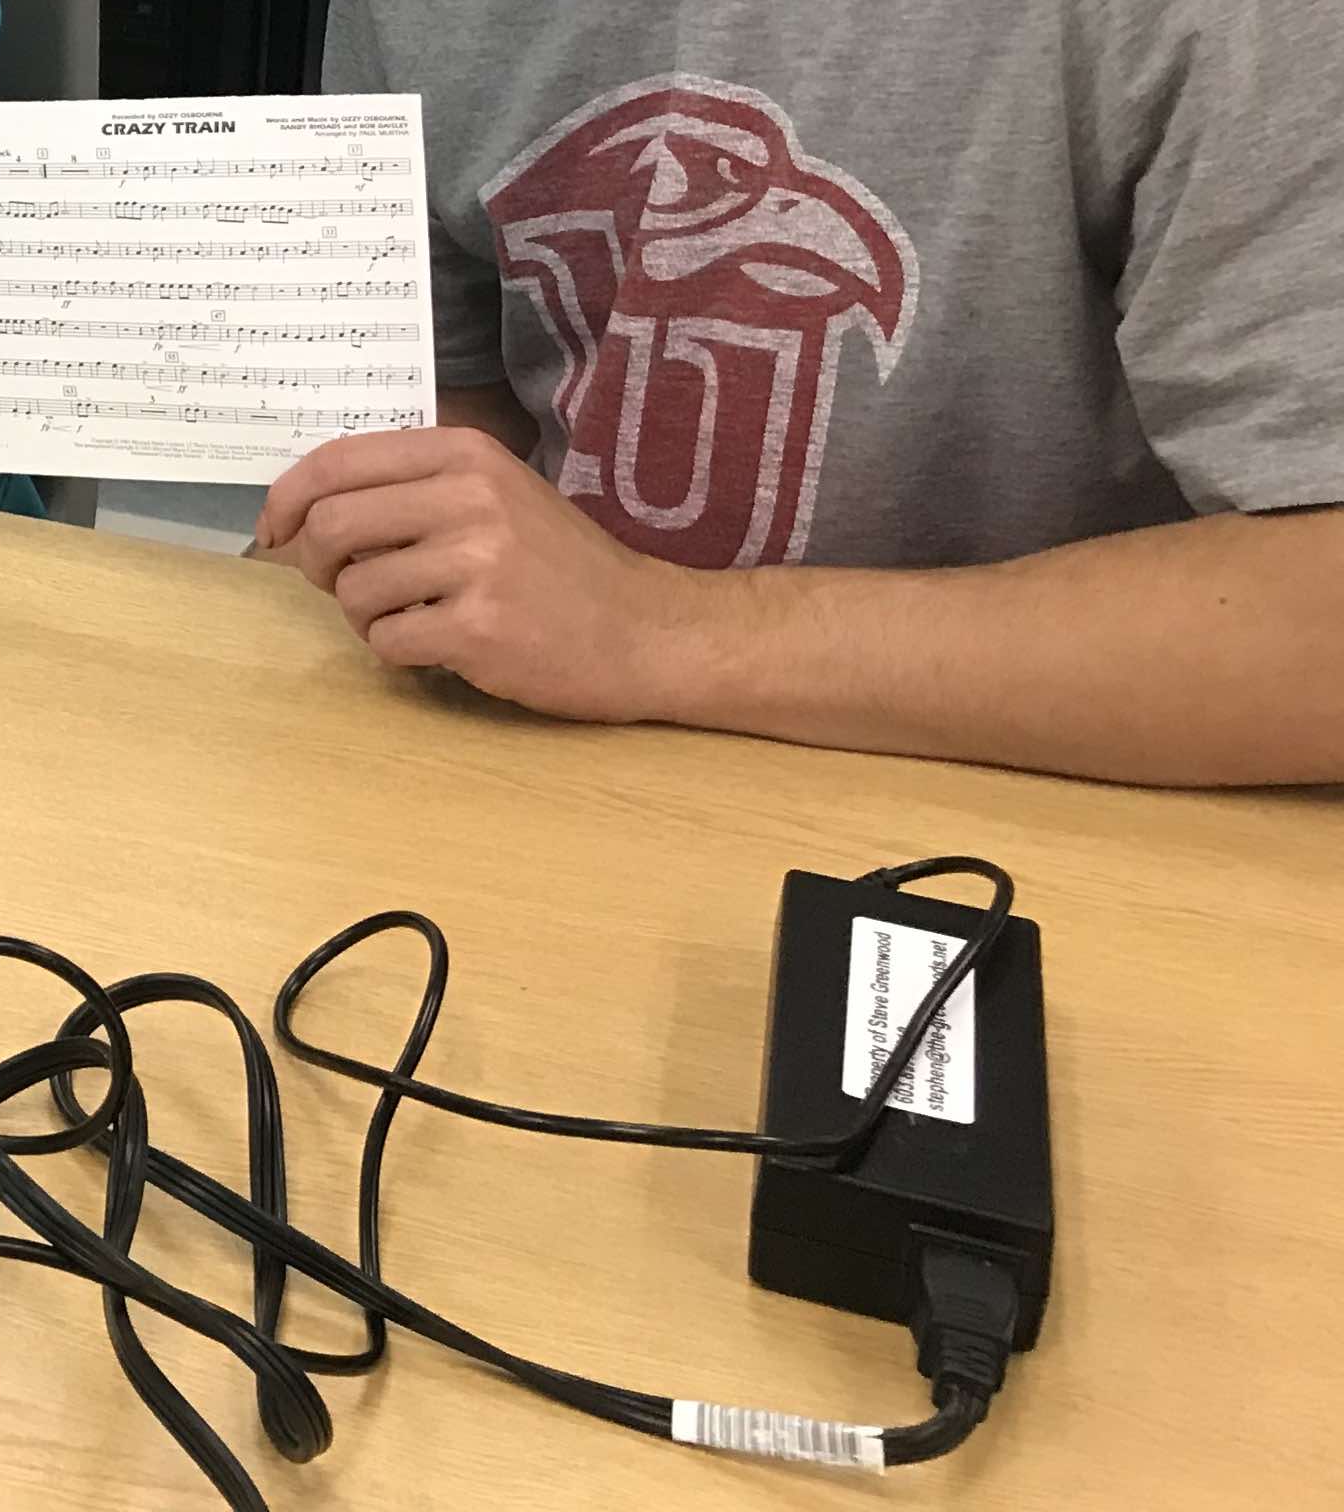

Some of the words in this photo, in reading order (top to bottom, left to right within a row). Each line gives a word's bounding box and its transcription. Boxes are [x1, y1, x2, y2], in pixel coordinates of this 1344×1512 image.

[101, 122, 167, 136] CRAZY
[172, 120, 236, 134] TRAIN
[870, 932, 892, 993] Greenwood
[868, 992, 889, 1029] Steve
[868, 1029, 889, 1044] of
